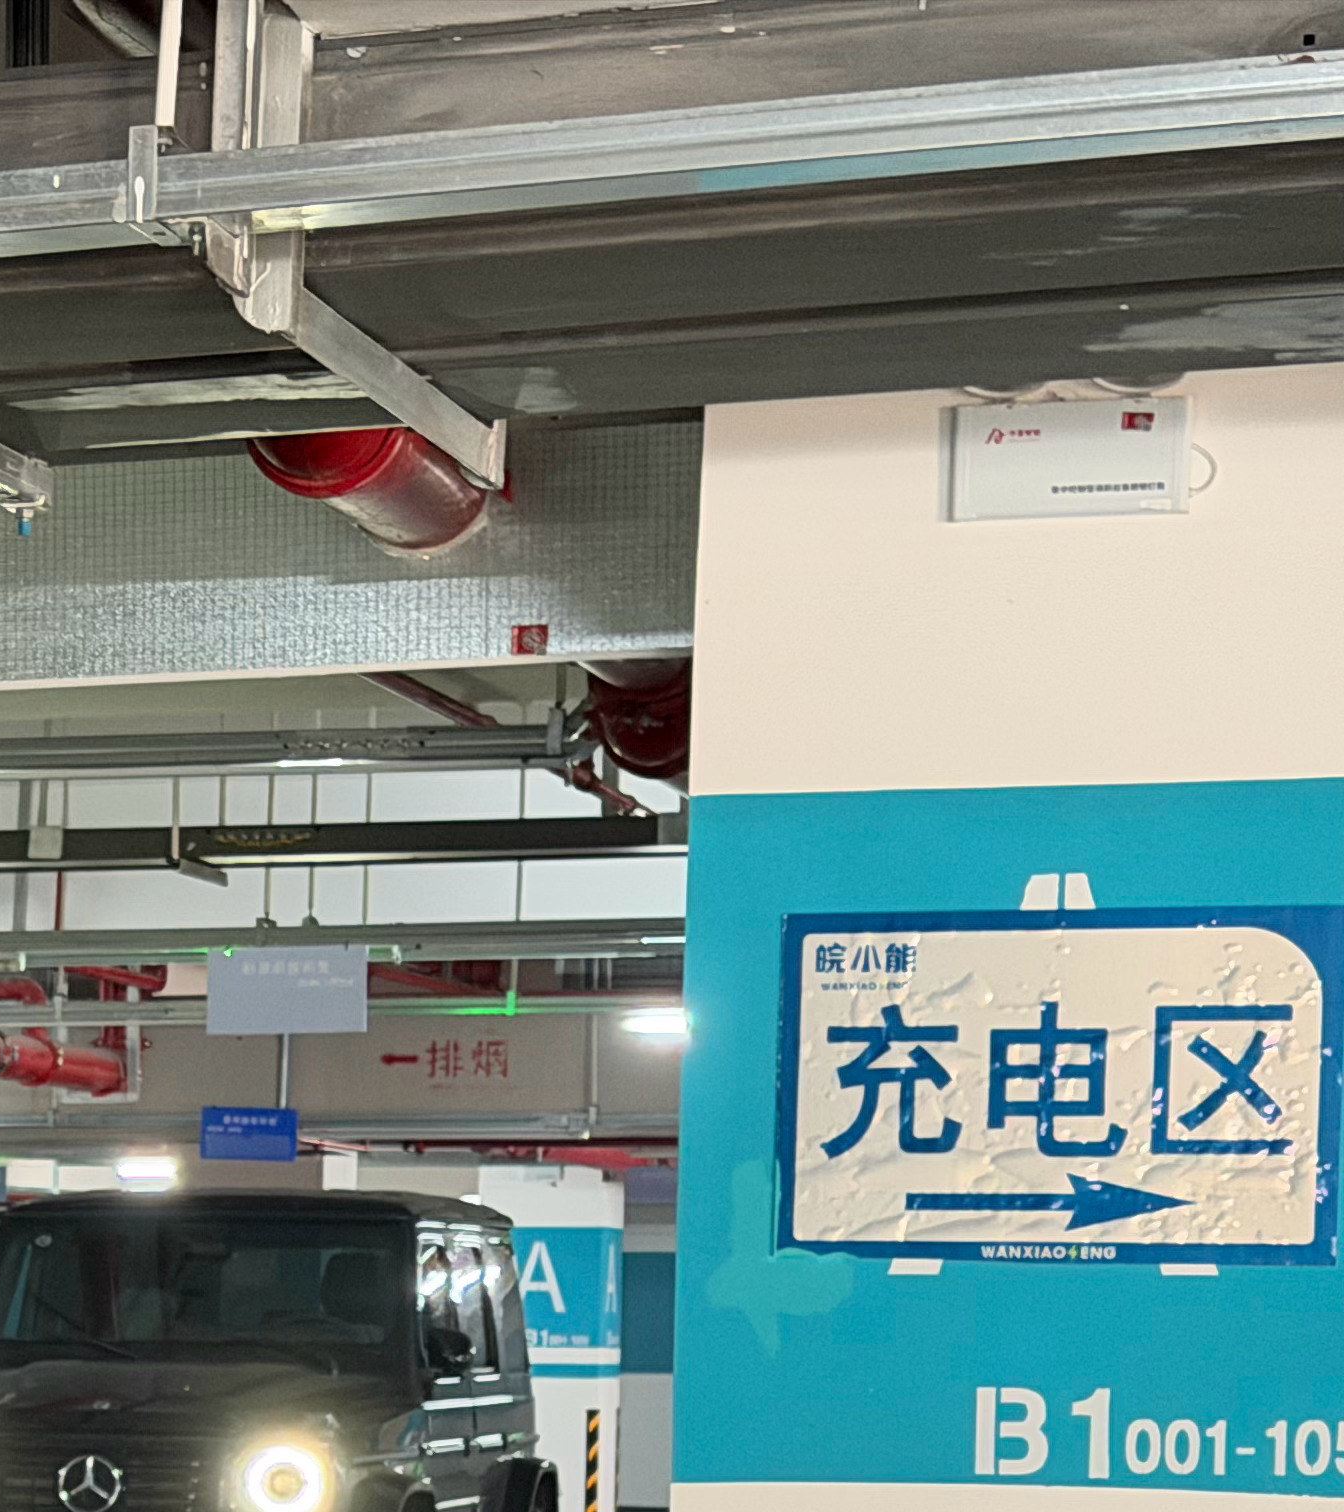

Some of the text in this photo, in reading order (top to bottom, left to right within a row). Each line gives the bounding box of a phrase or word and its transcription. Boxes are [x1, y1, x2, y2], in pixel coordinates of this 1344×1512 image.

[815, 942, 917, 973] 皖小能
[425, 1039, 508, 1078] 排烟
[819, 1001, 1294, 1160] 充电区
[518, 1241, 566, 1314] A
